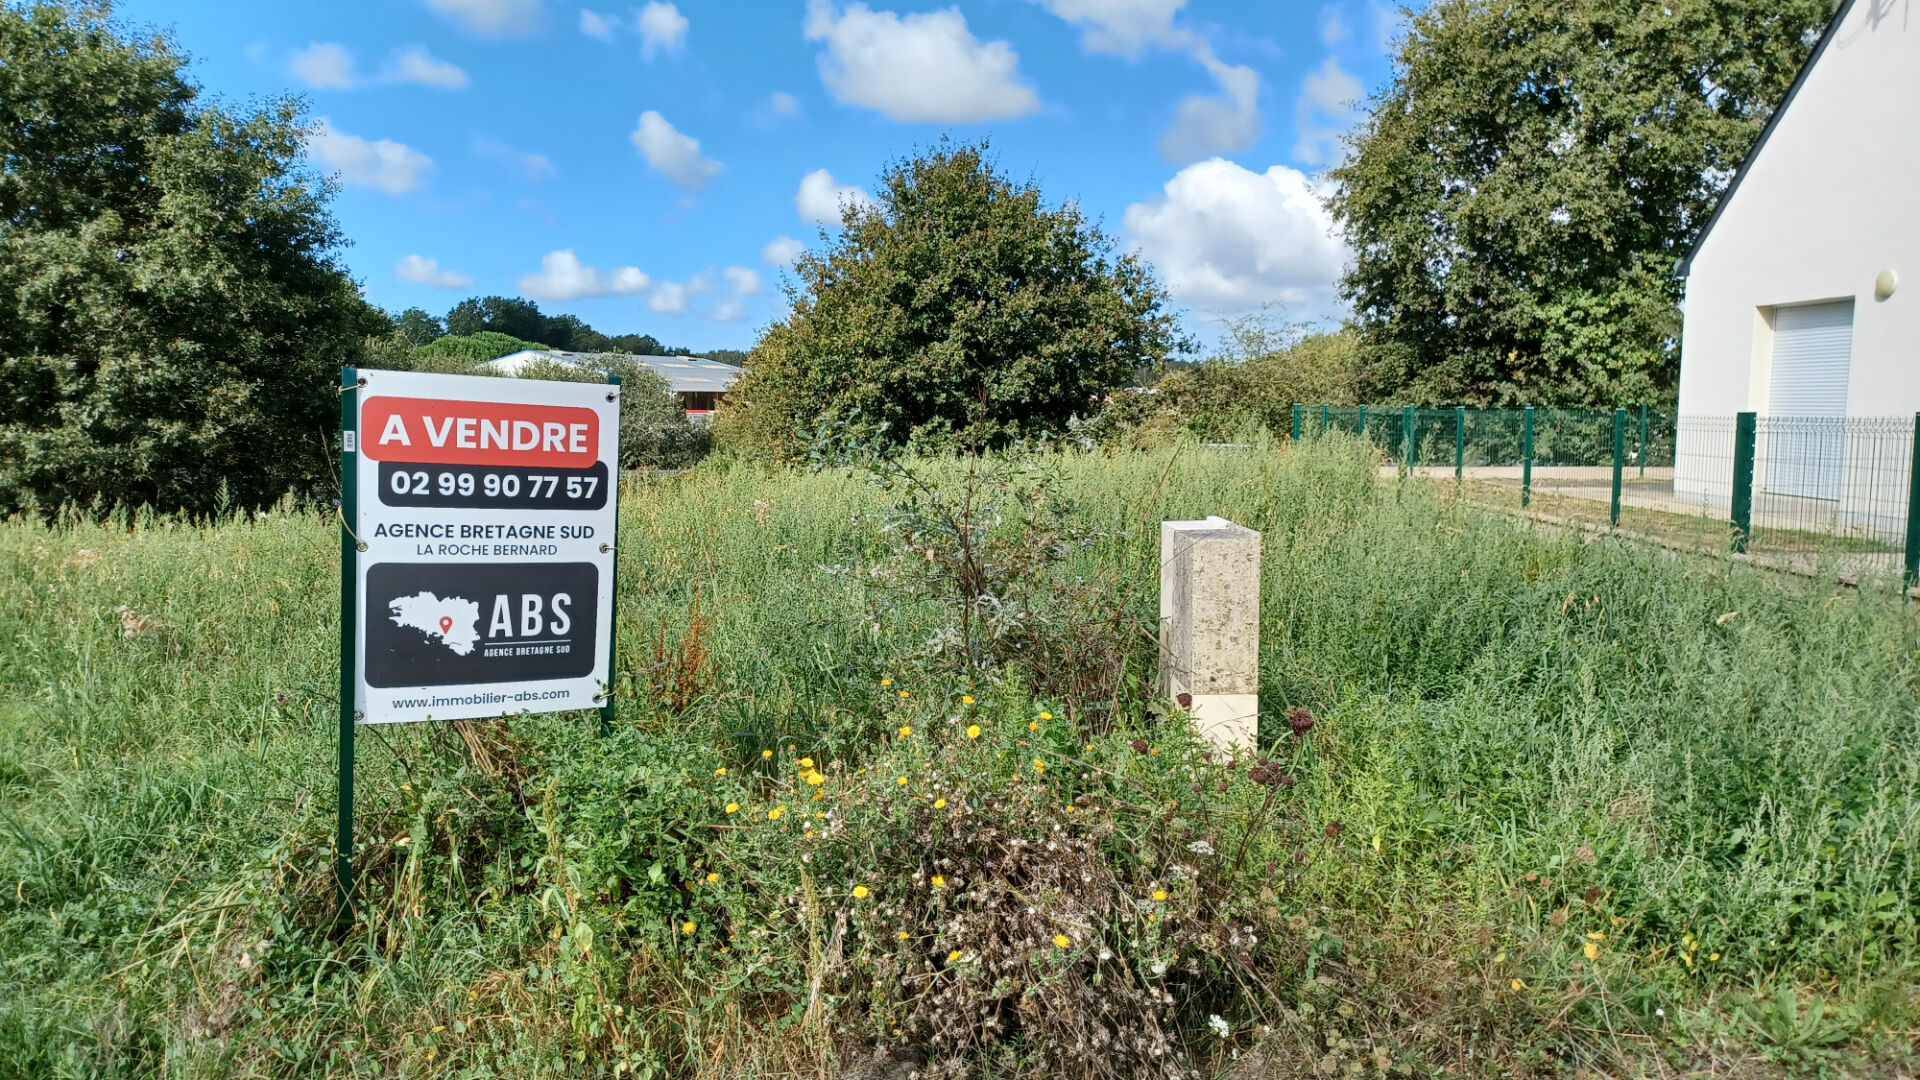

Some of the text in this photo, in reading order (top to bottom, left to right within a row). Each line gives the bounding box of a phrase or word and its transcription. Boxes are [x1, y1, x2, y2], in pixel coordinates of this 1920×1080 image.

[379, 414, 589, 454] A VENDRE
[391, 471, 599, 500] 02 99 90 77 57
[374, 523, 594, 539] AGENCE BRETAGNE SUD
[416, 544, 557, 556] LA ROCHE BERNARD
[488, 592, 573, 638] ABS
[484, 646, 513, 657] AGENCE
[515, 645, 554, 656] BRETAGNE
[392, 688, 570, 709] www.immobilier-abs.com
